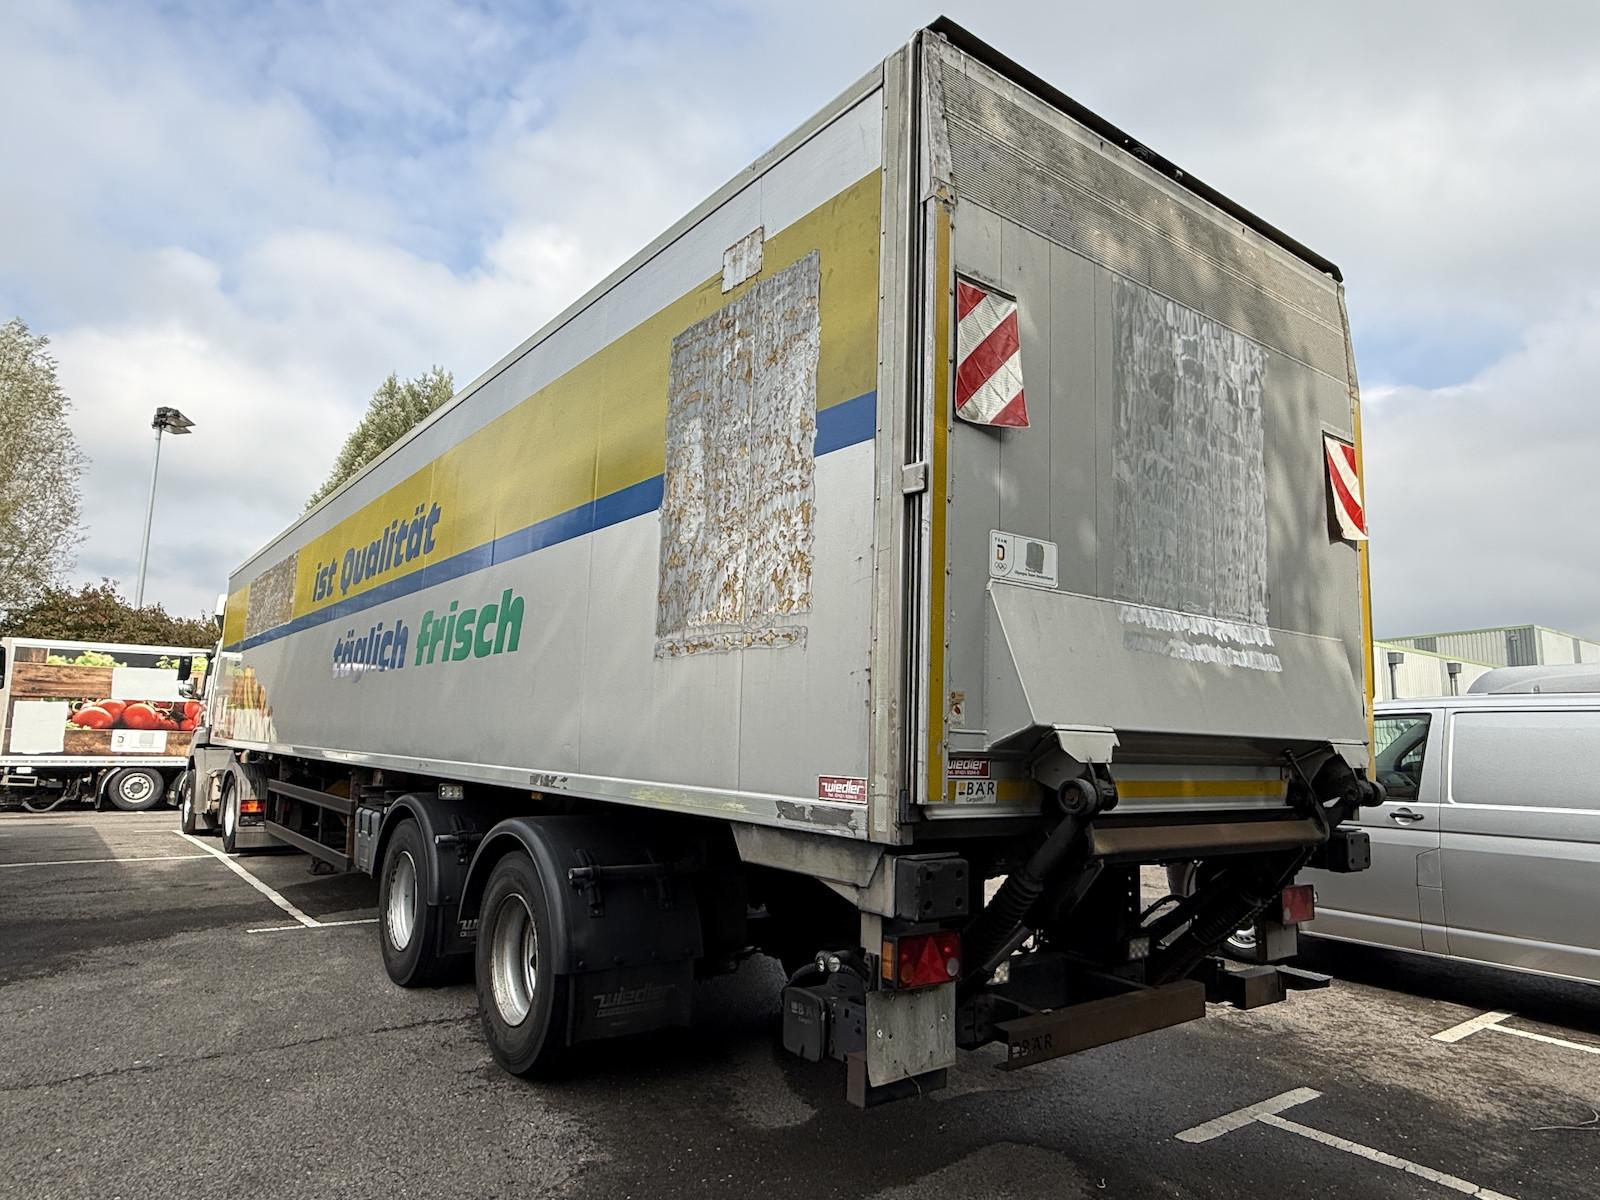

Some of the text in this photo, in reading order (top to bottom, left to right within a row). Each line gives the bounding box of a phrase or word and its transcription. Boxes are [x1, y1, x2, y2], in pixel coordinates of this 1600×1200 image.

[312, 501, 442, 602] ist Qualität
[332, 588, 525, 677] täglich frisch
[821, 779, 865, 795] wiedler
[966, 781, 995, 796] BÄR
[592, 981, 676, 1009] wiedler
